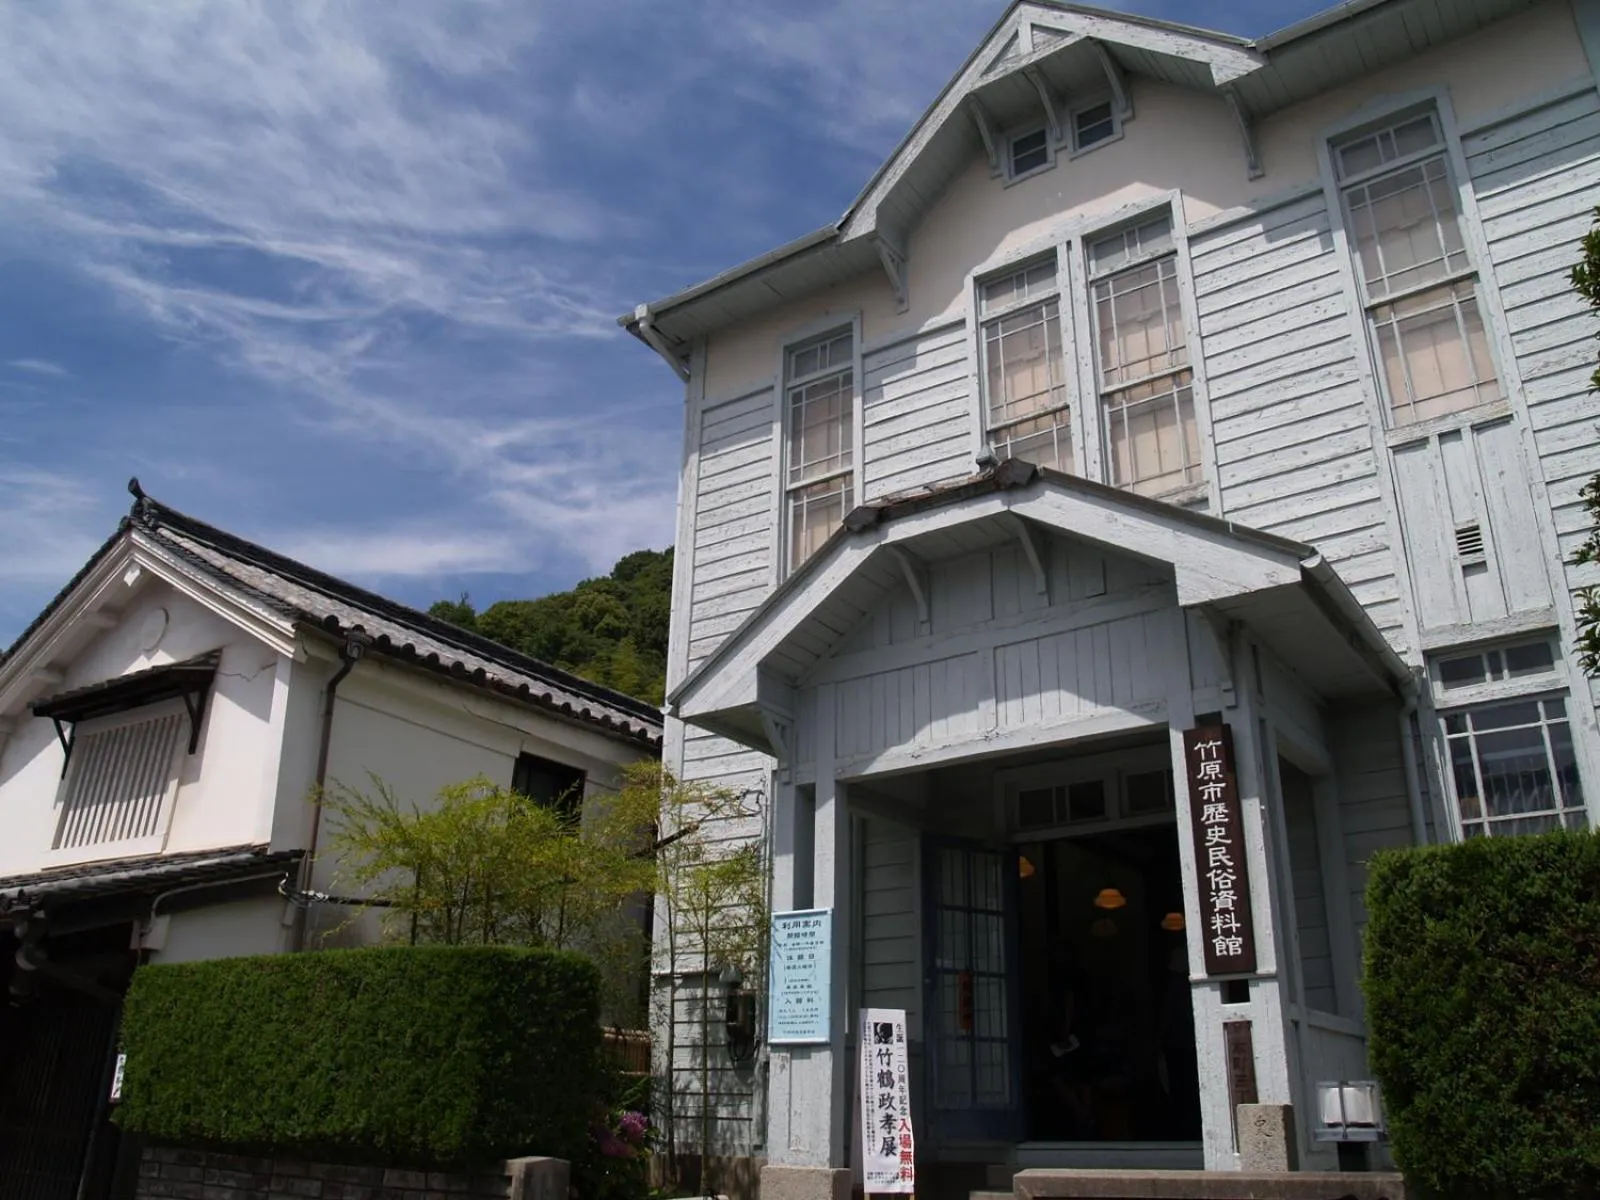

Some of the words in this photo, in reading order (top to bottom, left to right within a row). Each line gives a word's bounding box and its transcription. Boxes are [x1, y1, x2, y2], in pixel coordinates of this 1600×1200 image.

[1194, 740, 1243, 957] 竹原市歴史民俗資料館
[877, 1047, 897, 1157] 竹鶴政孝展
[899, 1118, 913, 1182] 入場無料
